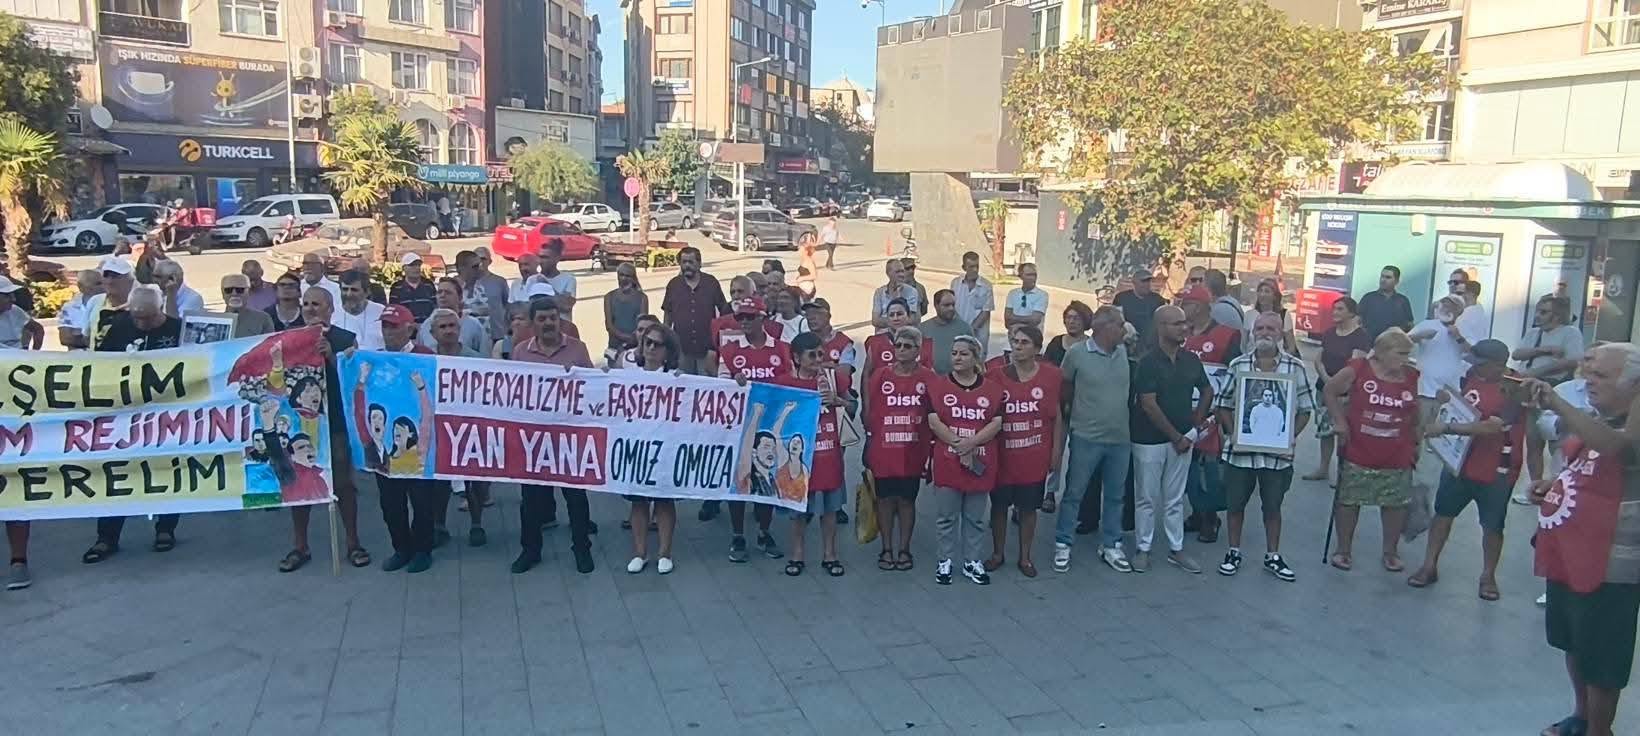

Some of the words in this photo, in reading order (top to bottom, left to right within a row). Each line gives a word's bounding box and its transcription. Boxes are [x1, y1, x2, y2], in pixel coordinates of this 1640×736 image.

[118, 50, 140, 61] IŞIK
[141, 52, 181, 64] HIZINDA
[239, 61, 276, 72] BURADA
[204, 144, 274, 160] TURKCELL
[448, 168, 480, 181] piyango
[742, 365, 775, 379] DİSK
[0, 361, 187, 417] ŞELİM
[438, 367, 586, 416] EMPERYALİZME
[588, 401, 606, 417] ve
[608, 382, 685, 424] FAŞİZME
[690, 387, 746, 430] KARŞI
[887, 393, 922, 407] DİSK
[952, 405, 987, 420] DİSK
[1006, 400, 1040, 414] DİSK
[64, 404, 252, 454] REJİMİNİ
[443, 421, 506, 470] YAN
[520, 430, 603, 480] YANA
[610, 440, 662, 485] OMUZ
[674, 443, 733, 490] OMUZA
